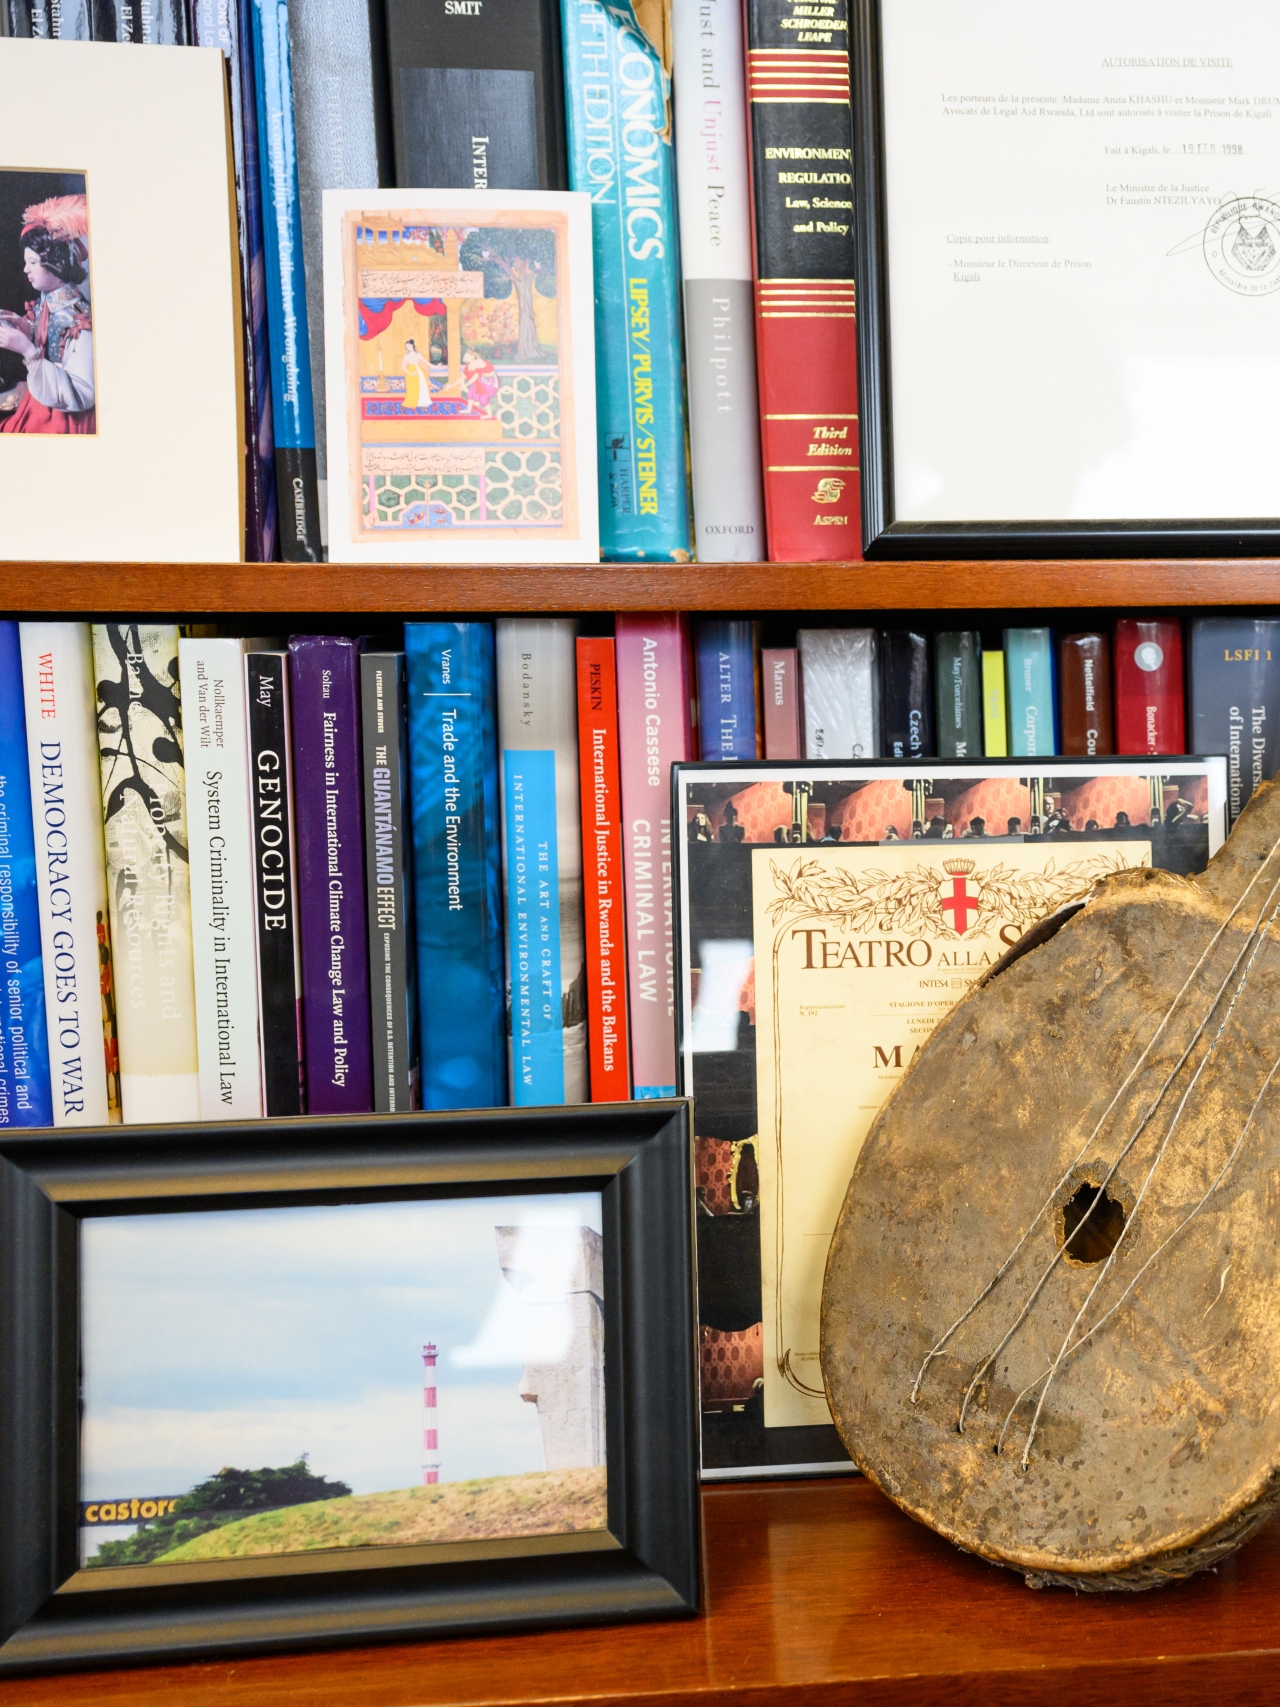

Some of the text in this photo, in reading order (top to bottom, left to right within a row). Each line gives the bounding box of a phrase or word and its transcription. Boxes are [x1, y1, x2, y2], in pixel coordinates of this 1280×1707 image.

[445, 1, 482, 14] SMIT
[781, 19, 847, 30] SCHROEDER
[793, 6, 834, 16] MILLER
[798, 32, 832, 42] LEAPE
[1102, 57, 1233, 67] AUTORISATION DE VISITE
[583, 84, 616, 204] EDITION
[611, 7, 664, 260] ECONOMICS
[700, 47, 725, 246] and Unjust Peace
[1105, 146, 1121, 155] Fait
[1124, 146, 1129, 154] à
[1131, 146, 1160, 156] Kigali,
[1163, 146, 1170, 154] le
[1182, 144, 1193, 154] 19
[1222, 144, 1243, 154] 1998
[1106, 183, 1209, 193] Le Ministre de la Justice
[629, 278, 657, 516] LIPSEY/PURVIS/STEINER
[710, 297, 732, 414] Philpott
[807, 444, 852, 457] Edition
[814, 427, 848, 439] Third
[705, 525, 754, 535] OXFORD
[520, 653, 533, 727] Bodansky
[642, 637, 661, 787] Antonio Cassese
[719, 651, 733, 703] ALTER
[773, 660, 785, 706] Marrus
[1224, 649, 1273, 661] LSFI 1
[256, 675, 287, 931] May GENOCIDE
[372, 746, 397, 930] THE GUANTÁNAMO EFFECT
[441, 649, 463, 911] Vranes Trade and the Environment
[38, 652, 87, 1118] WHITE DEMOCRACY GOES TO WAR
[322, 670, 349, 1087] Soltau Fairness in International Climate Change Law and Policy
[589, 663, 617, 1072] PESKIN International Justice in Rwanda and the Balkans
[632, 819, 657, 1003] CRIMINAL LAW
[203, 771, 236, 1105] System Criminality in International Law
[513, 775, 532, 1086] INTERNATIONAL ENVIRONMENTAL LAW
[538, 842, 552, 1019] THE ART AND CRAFT OF
[792, 929, 992, 969] TEATRO ALLA
